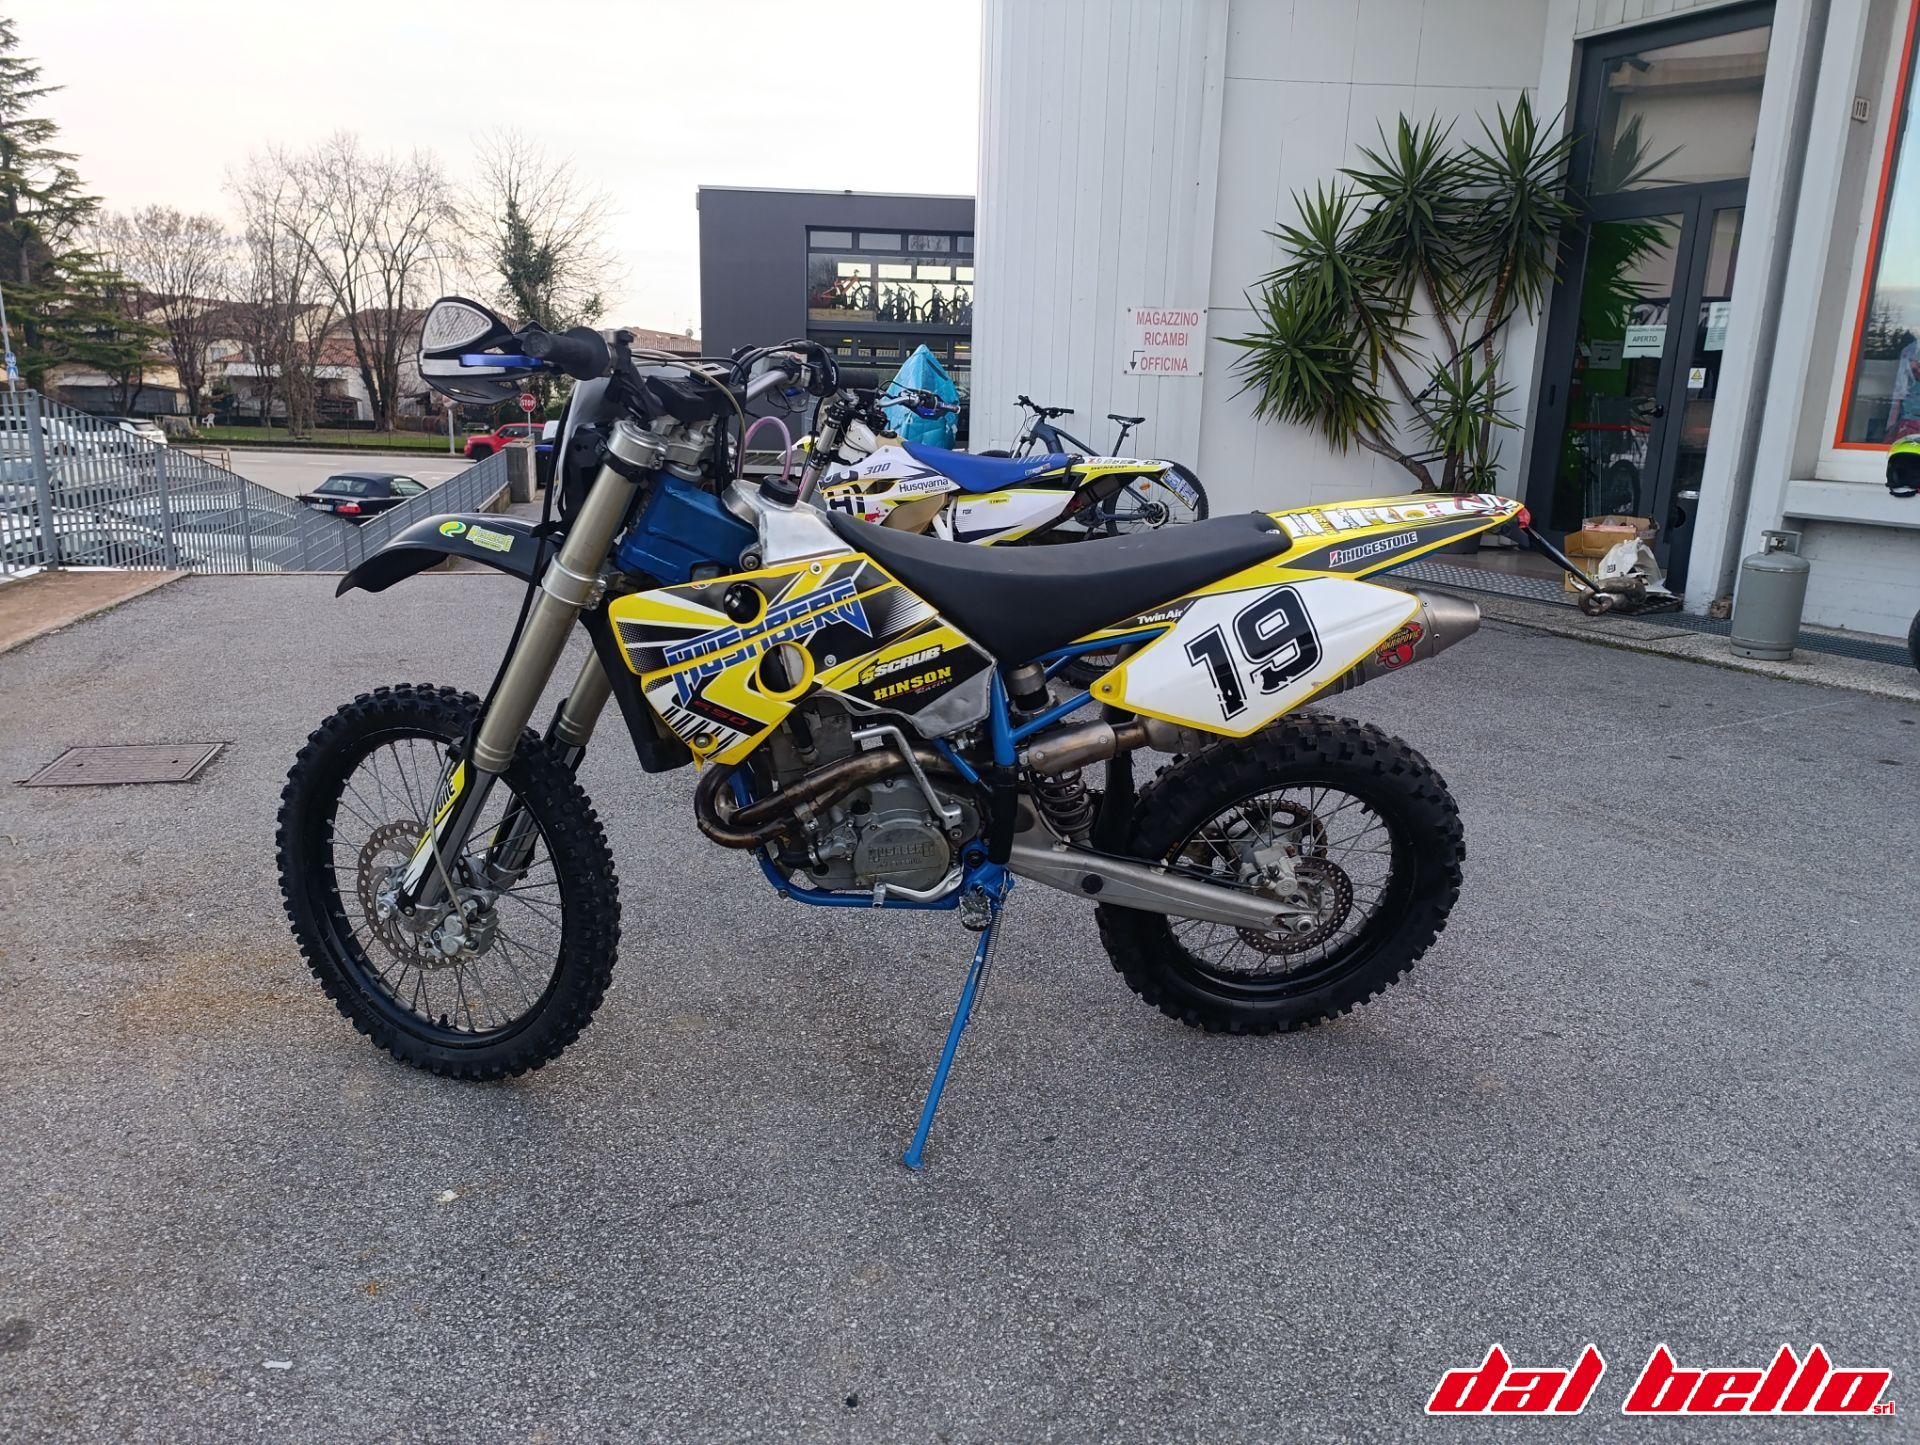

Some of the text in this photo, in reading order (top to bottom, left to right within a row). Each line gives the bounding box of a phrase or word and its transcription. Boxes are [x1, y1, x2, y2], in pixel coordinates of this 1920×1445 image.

[1136, 311, 1199, 326] MAGAZZINO
[1143, 332, 1189, 346] RICAMBI
[1140, 356, 1189, 371] OFFICINA
[864, 462, 892, 475] 300
[899, 478, 949, 493] Husqvarna
[1329, 531, 1418, 568] BRIDGESTONE
[1184, 585, 1323, 721] 19
[873, 666, 951, 700] HINSON
